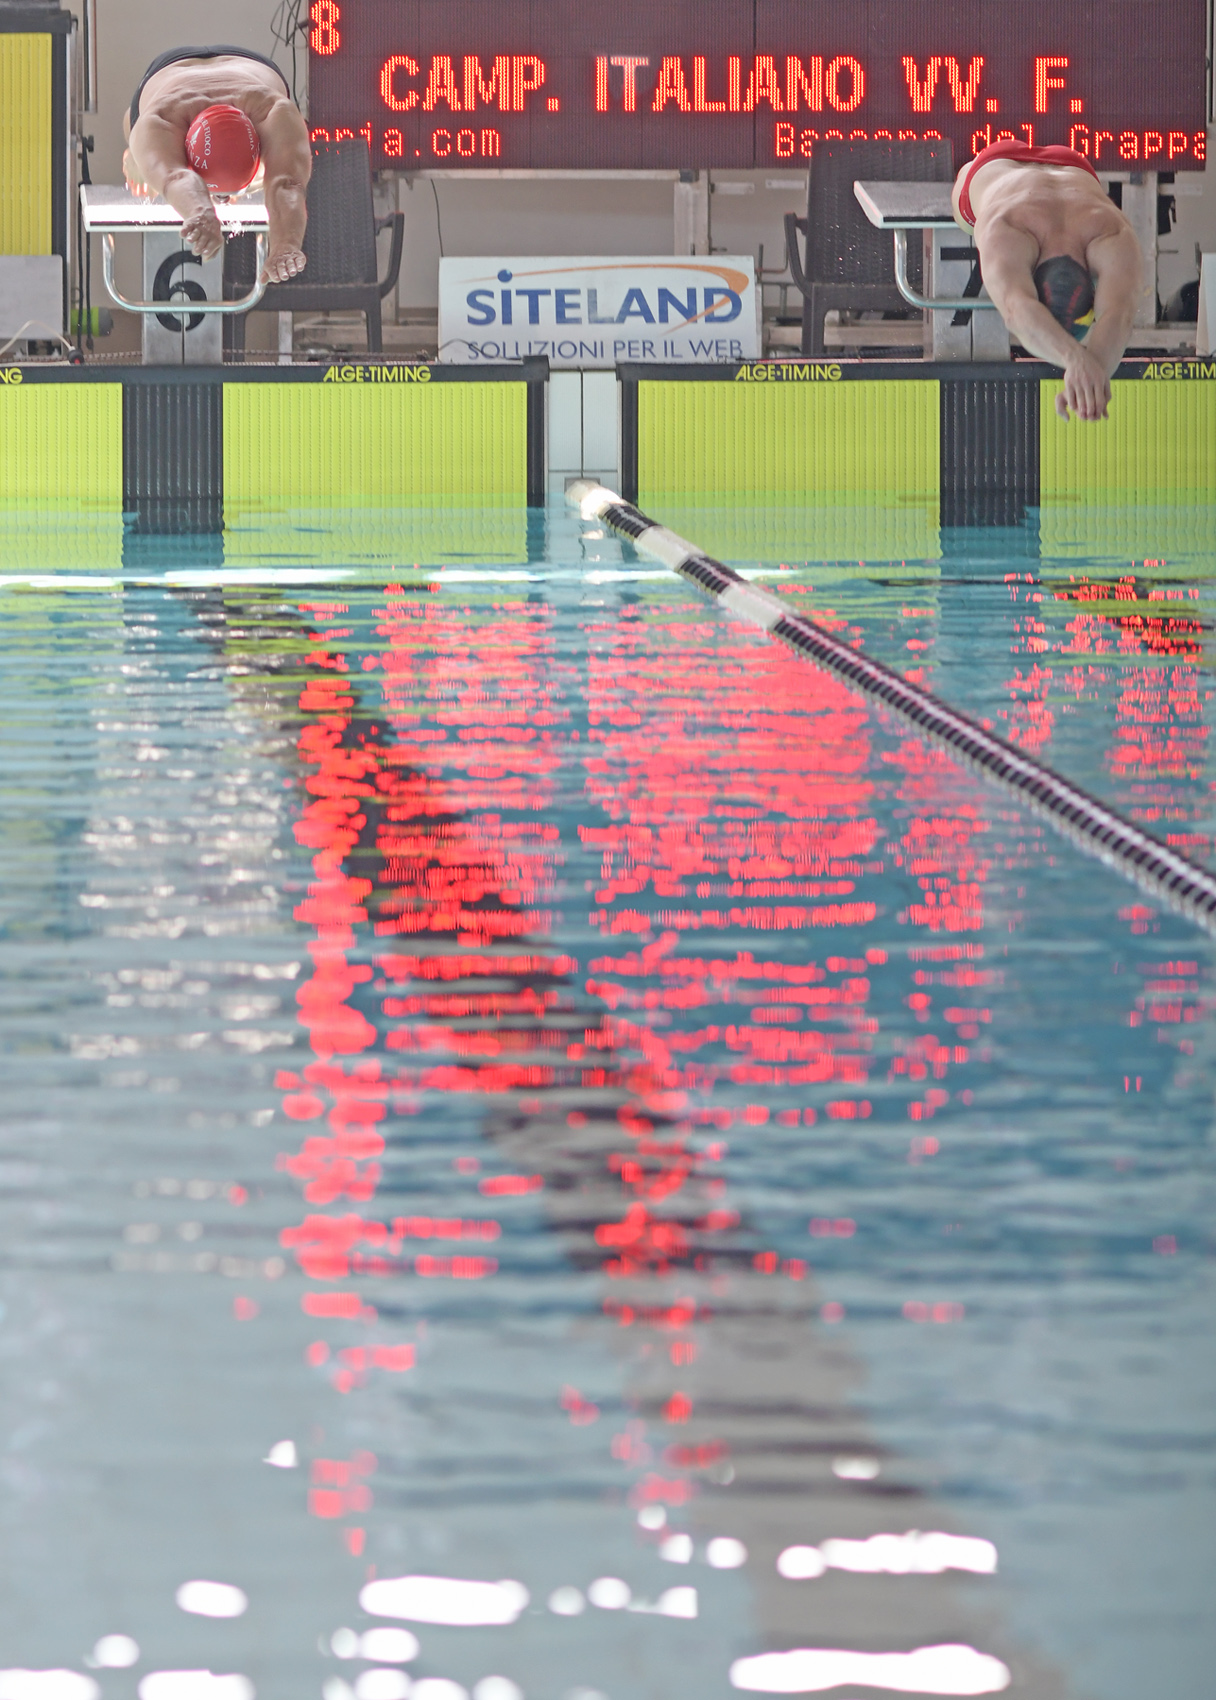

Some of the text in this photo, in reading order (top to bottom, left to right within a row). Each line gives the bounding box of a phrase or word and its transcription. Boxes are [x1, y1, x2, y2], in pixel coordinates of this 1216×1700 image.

[310, 0, 341, 55] 8
[379, 55, 560, 112] CAMP.
[596, 55, 866, 113] ITALIANO
[1034, 57, 1084, 114] F.
[153, 250, 208, 333] 6
[940, 247, 985, 327] 7
[614, 340, 655, 358] PER
[663, 339, 684, 358] IL
[688, 339, 744, 360] WEB
